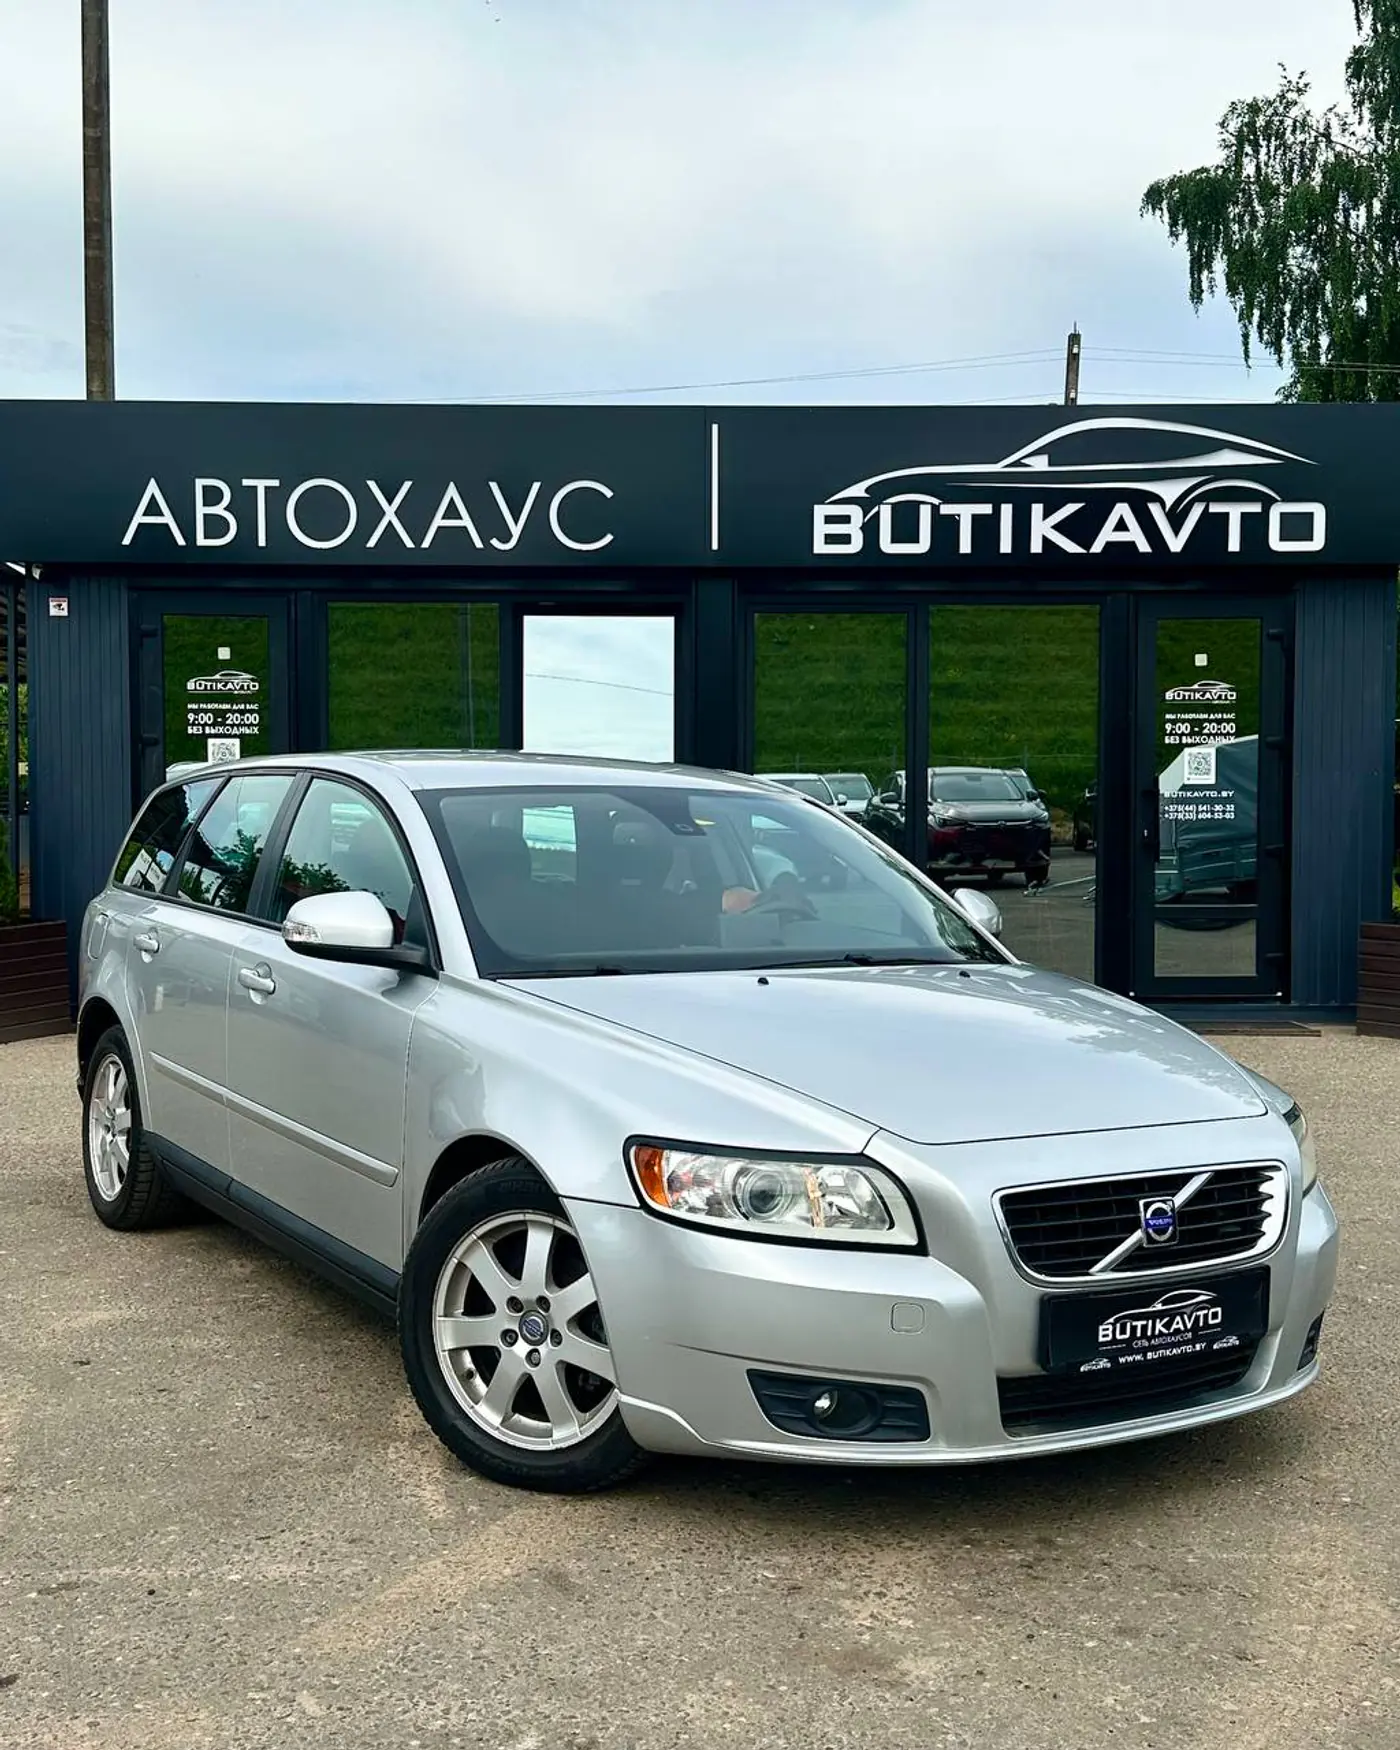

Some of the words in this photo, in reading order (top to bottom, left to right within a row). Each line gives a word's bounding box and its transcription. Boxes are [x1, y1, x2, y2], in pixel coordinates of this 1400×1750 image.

[121, 477, 615, 551] АВТОХАУС
[812, 501, 1327, 554] BUTIKAVTO
[186, 681, 260, 691] BUTIKAVTO
[1164, 691, 1237, 700] BUTIKAVTO
[187, 712, 214, 725] 9:00
[225, 712, 260, 725] 20:00
[187, 725, 203, 734] БЕЗ
[204, 725, 260, 735] ВЫХОДНЫХ
[1164, 722, 1191, 734] 9:00
[1202, 722, 1236, 734] 20:00
[1164, 735, 1180, 744] БЕЗ
[1181, 735, 1236, 745] ВЫХОДНЫХ
[1098, 1307, 1222, 1342] BUTIKAVTO
[1132, 1339, 1149, 1348] СЕТЬ
